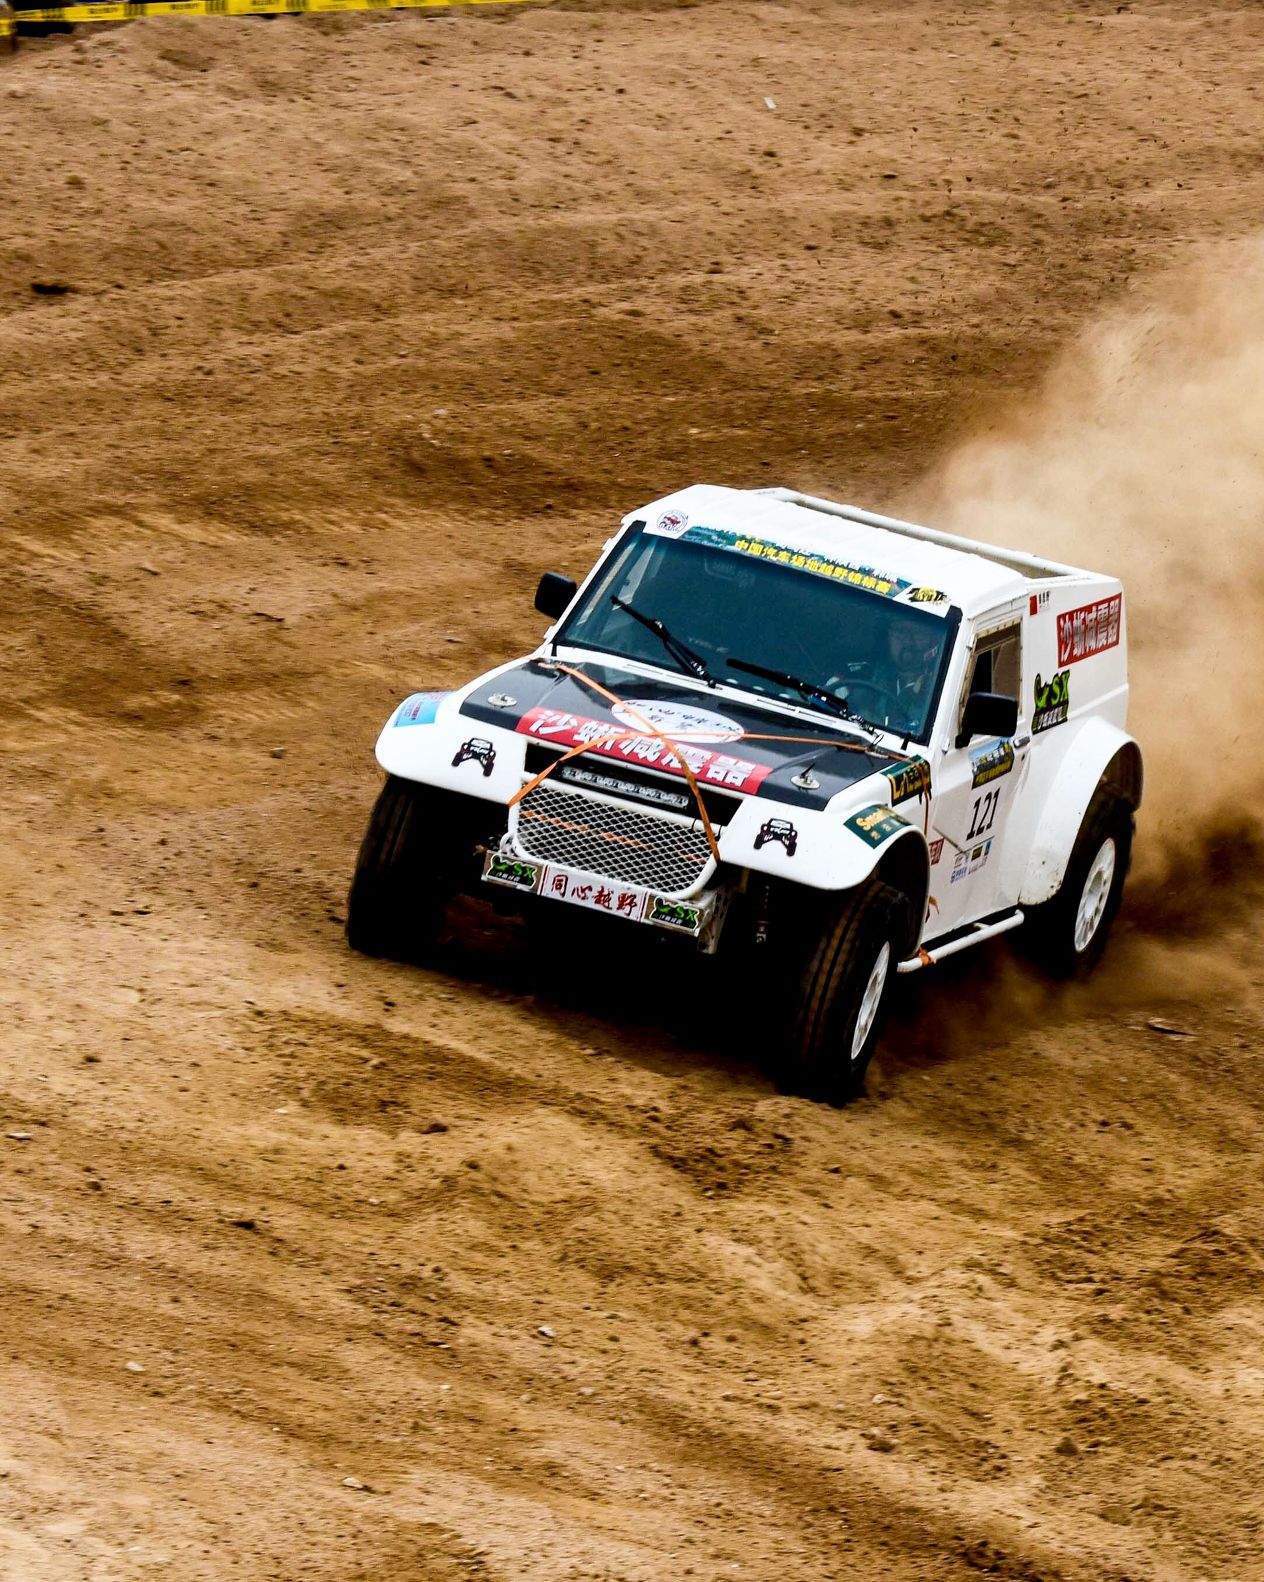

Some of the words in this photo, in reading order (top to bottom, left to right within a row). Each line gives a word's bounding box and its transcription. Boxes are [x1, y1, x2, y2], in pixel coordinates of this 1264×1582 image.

[966, 787, 1000, 841] 121
[551, 873, 638, 917] 同心越野
